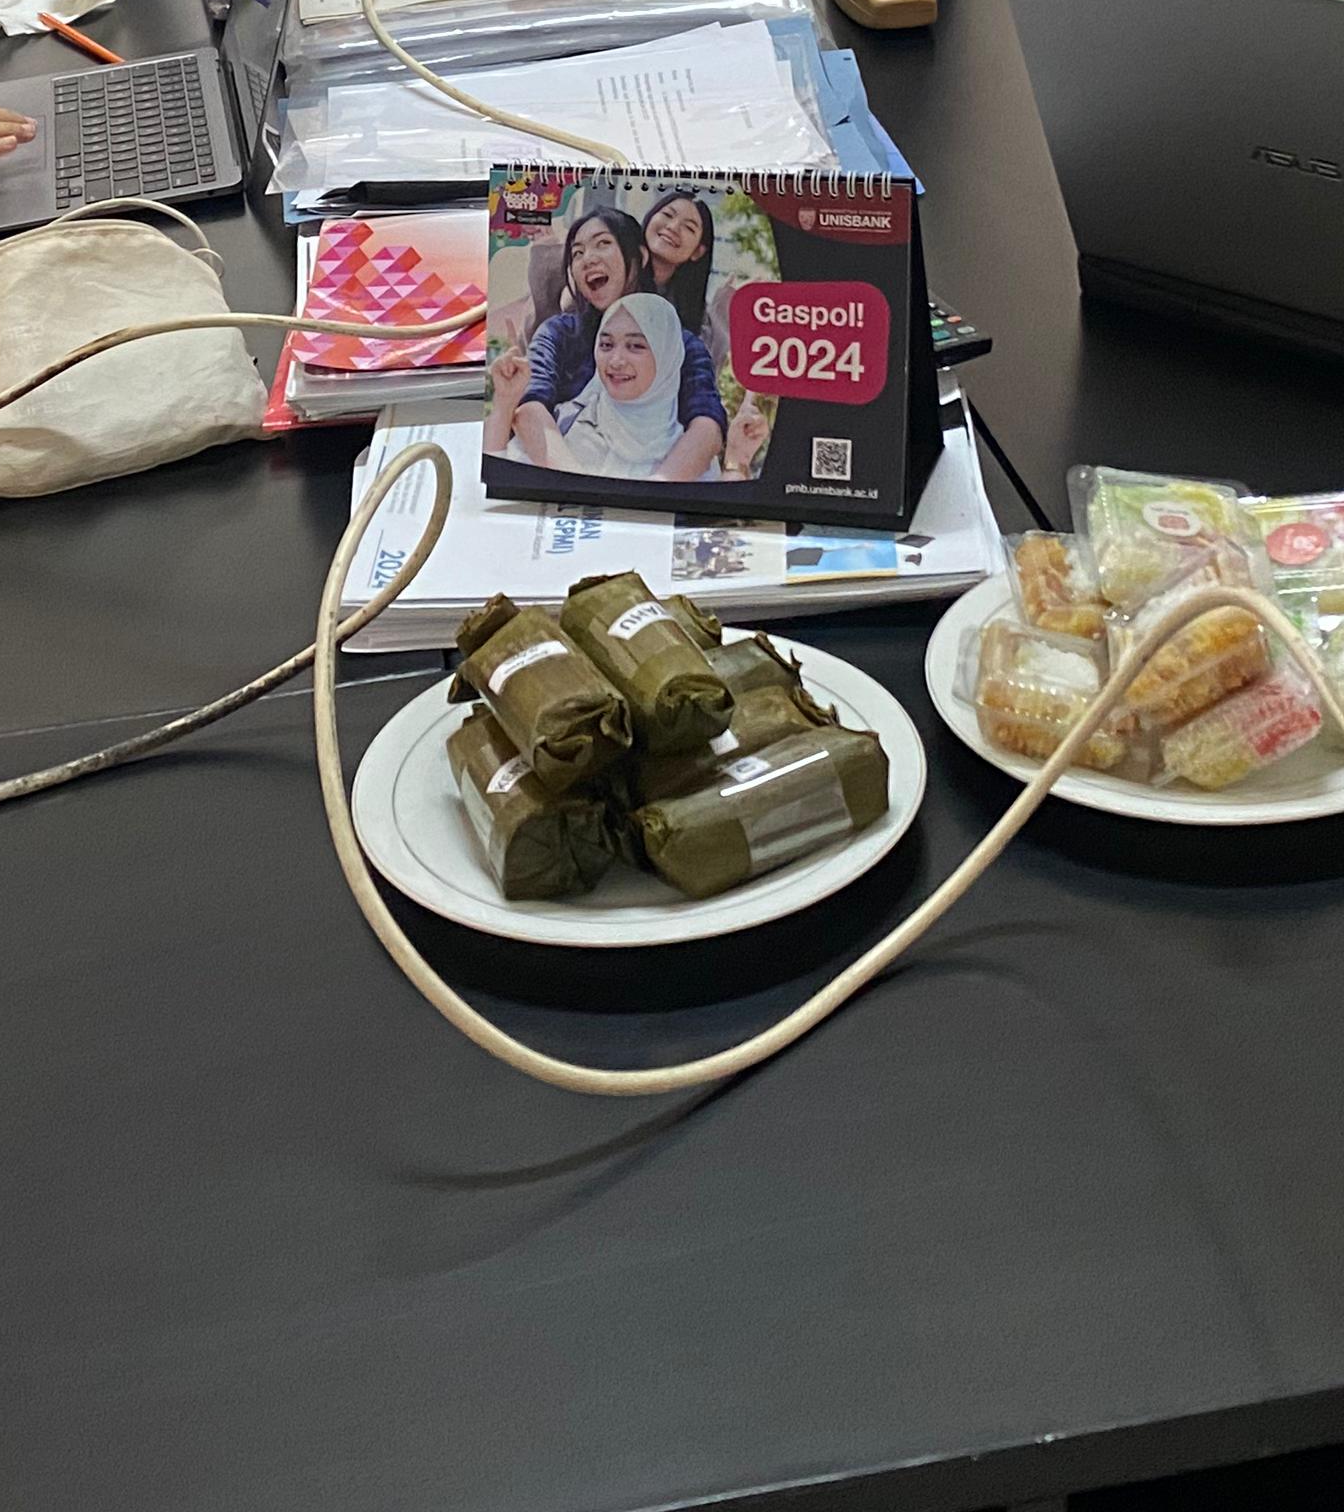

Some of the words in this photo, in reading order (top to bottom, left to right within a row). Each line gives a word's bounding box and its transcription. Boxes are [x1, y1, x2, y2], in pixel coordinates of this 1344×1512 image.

[1250, 145, 1344, 183] ASUS
[819, 213, 892, 229] UNISBANK
[753, 297, 864, 330] Gaspol!
[750, 335, 864, 382] 2024
[784, 482, 878, 500] pmb.unisbank.ac.id
